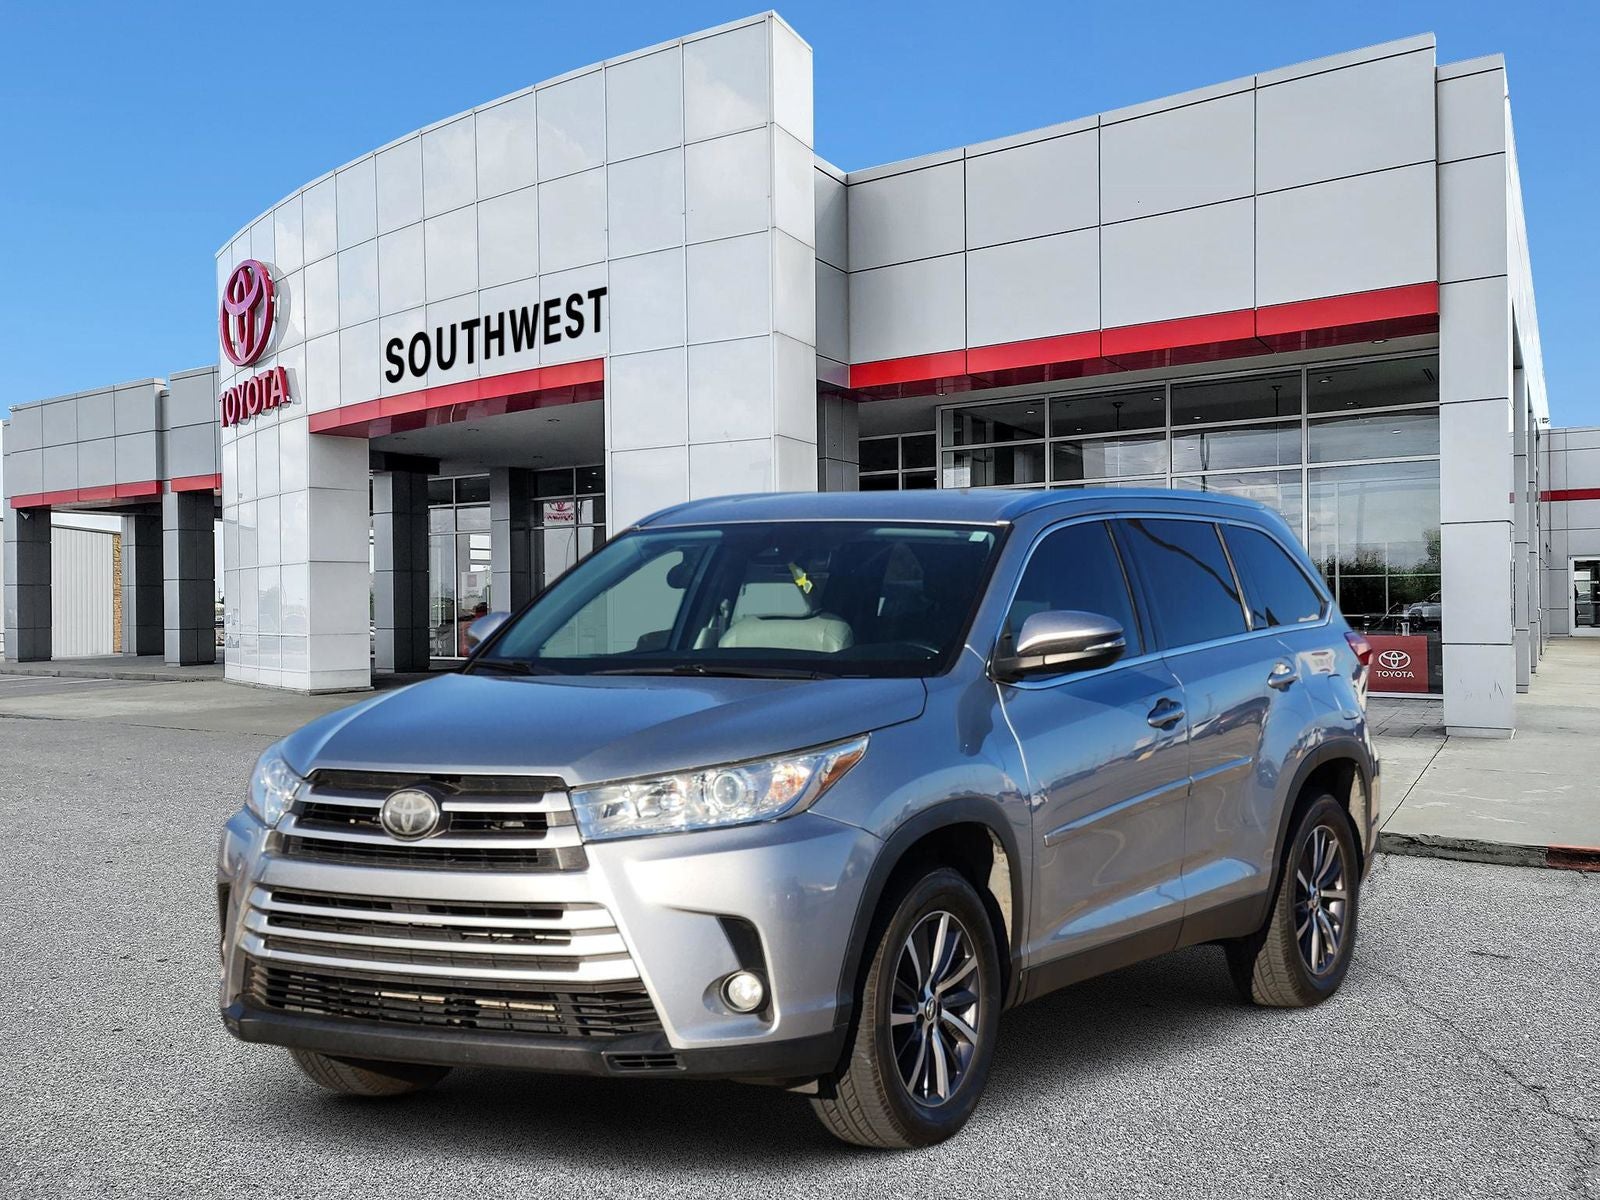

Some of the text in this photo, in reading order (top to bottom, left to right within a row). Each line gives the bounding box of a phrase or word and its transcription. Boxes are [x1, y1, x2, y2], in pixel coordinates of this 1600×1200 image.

[385, 286, 608, 384] SOUTHWEST
[219, 366, 291, 427] TOYOTA
[1376, 670, 1415, 678] TOYOTA
